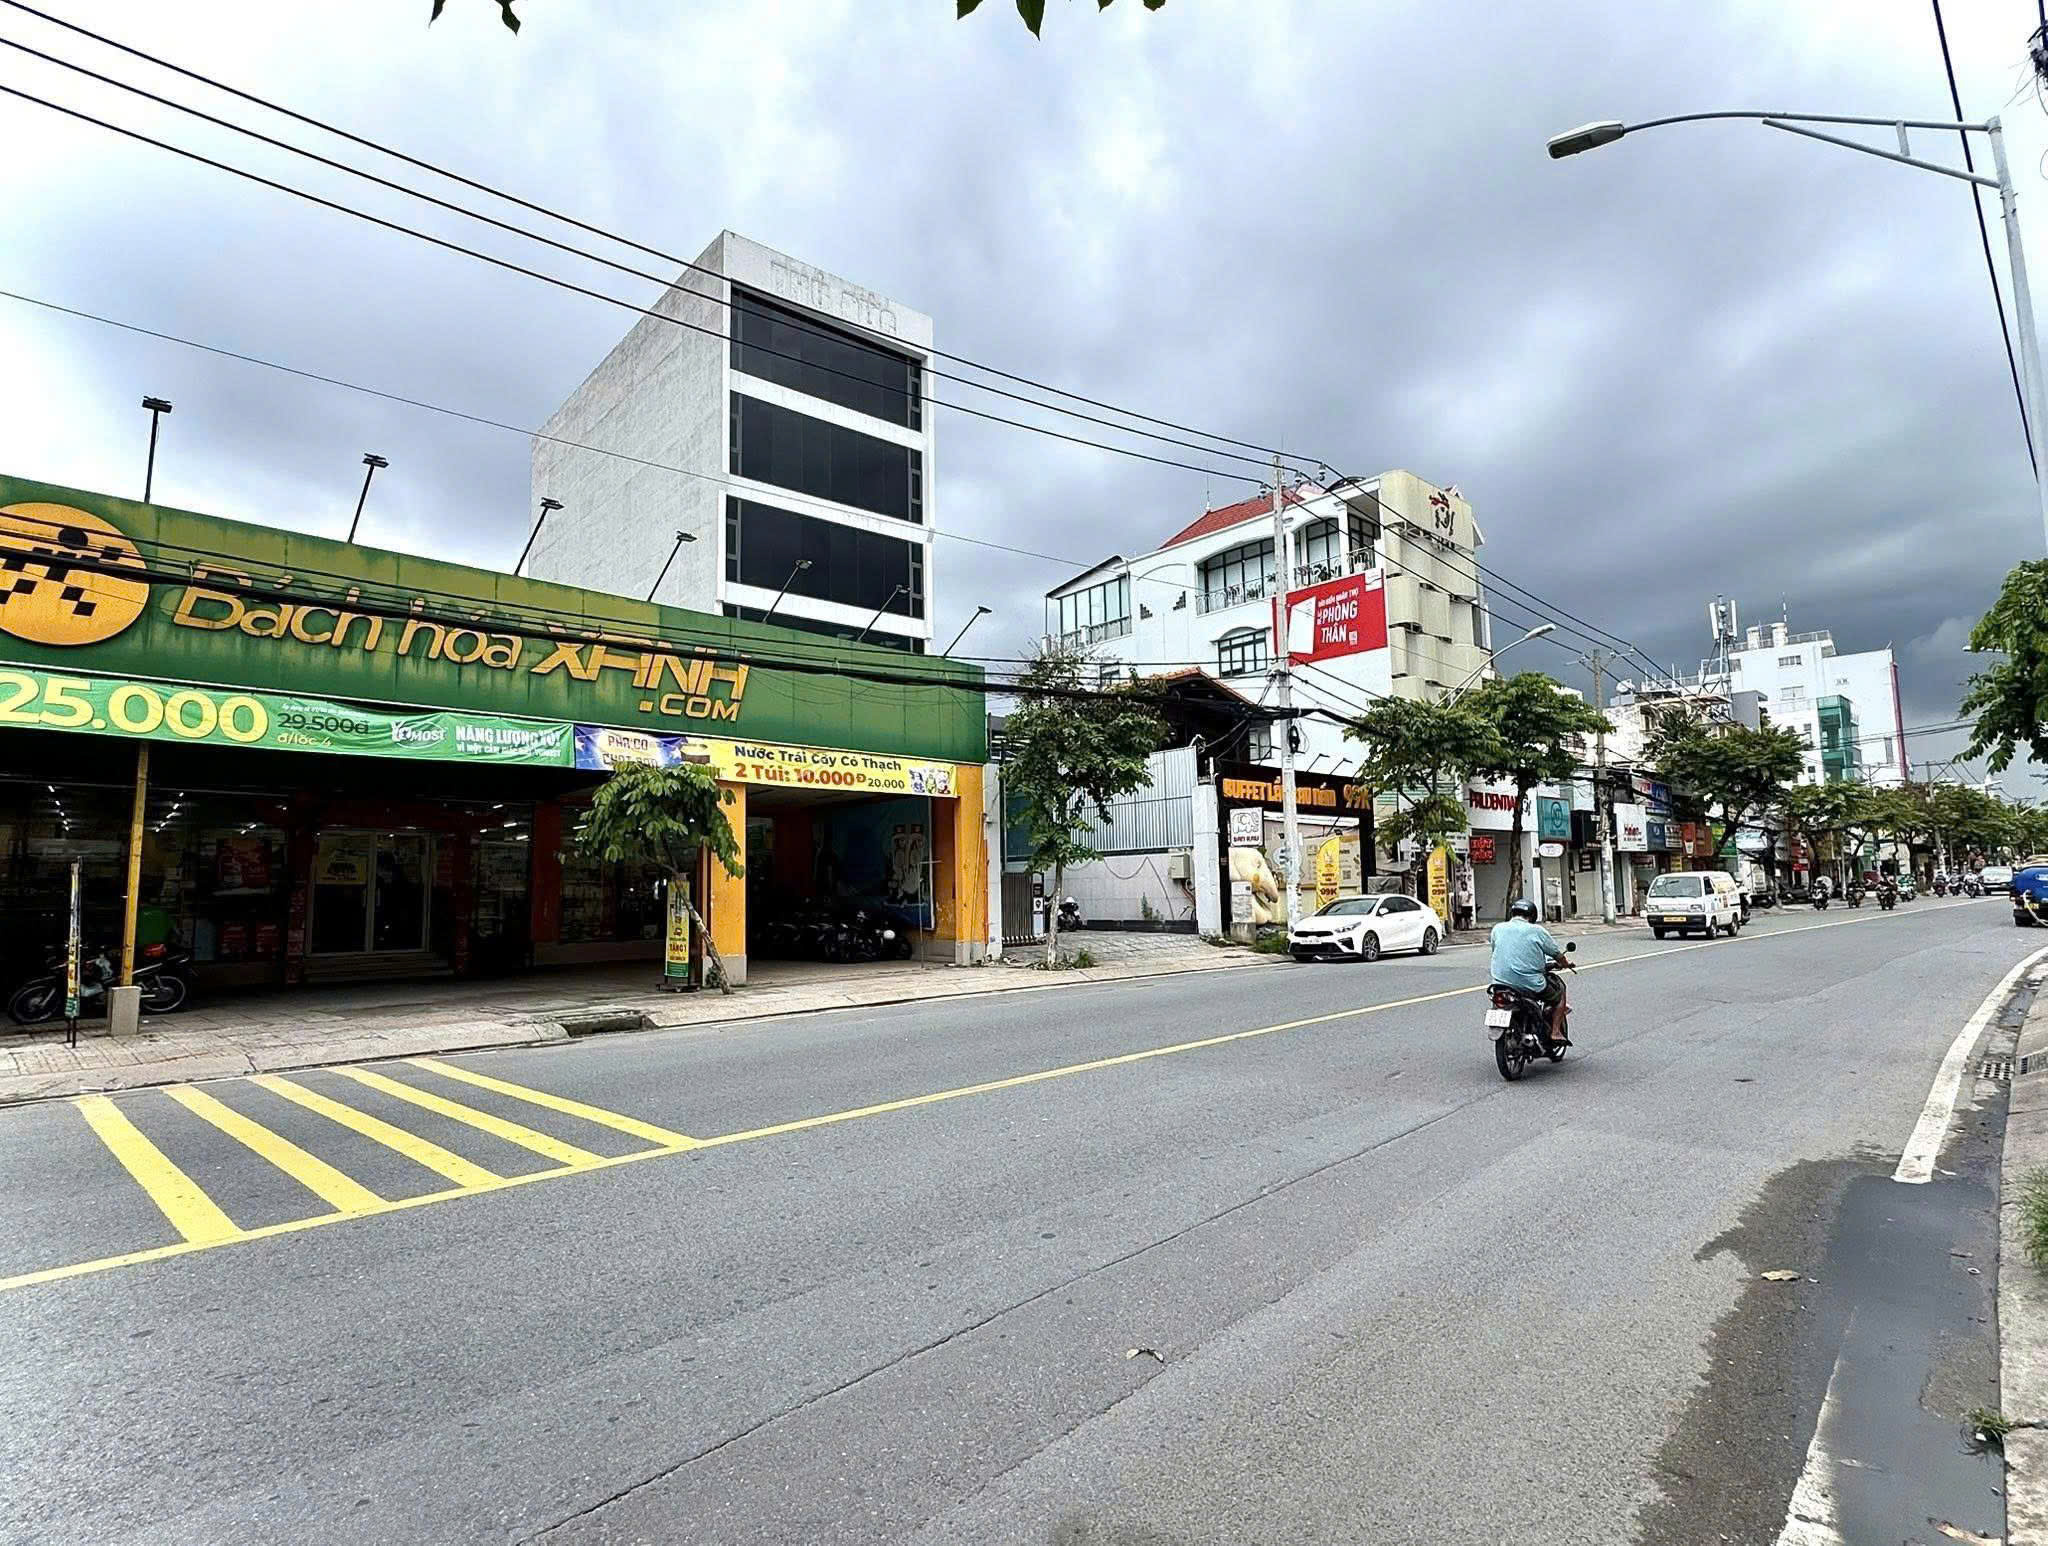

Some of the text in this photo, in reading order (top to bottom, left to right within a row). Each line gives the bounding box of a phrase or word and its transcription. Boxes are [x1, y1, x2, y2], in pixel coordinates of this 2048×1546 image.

[173, 562, 383, 651] Bách
[397, 597, 524, 669] hóa
[1323, 600, 1358, 625] PHÒNG
[1321, 622, 1347, 643] THÂN
[0, 672, 269, 742] 25.000
[734, 745, 775, 761] Nước
[781, 749, 806, 764] Trái
[862, 757, 902, 772] Thạch
[735, 762, 747, 778] 2
[752, 764, 790, 782] Túi:
[868, 777, 905, 789] 20.000
[1222, 777, 1265, 801] BUFFET
